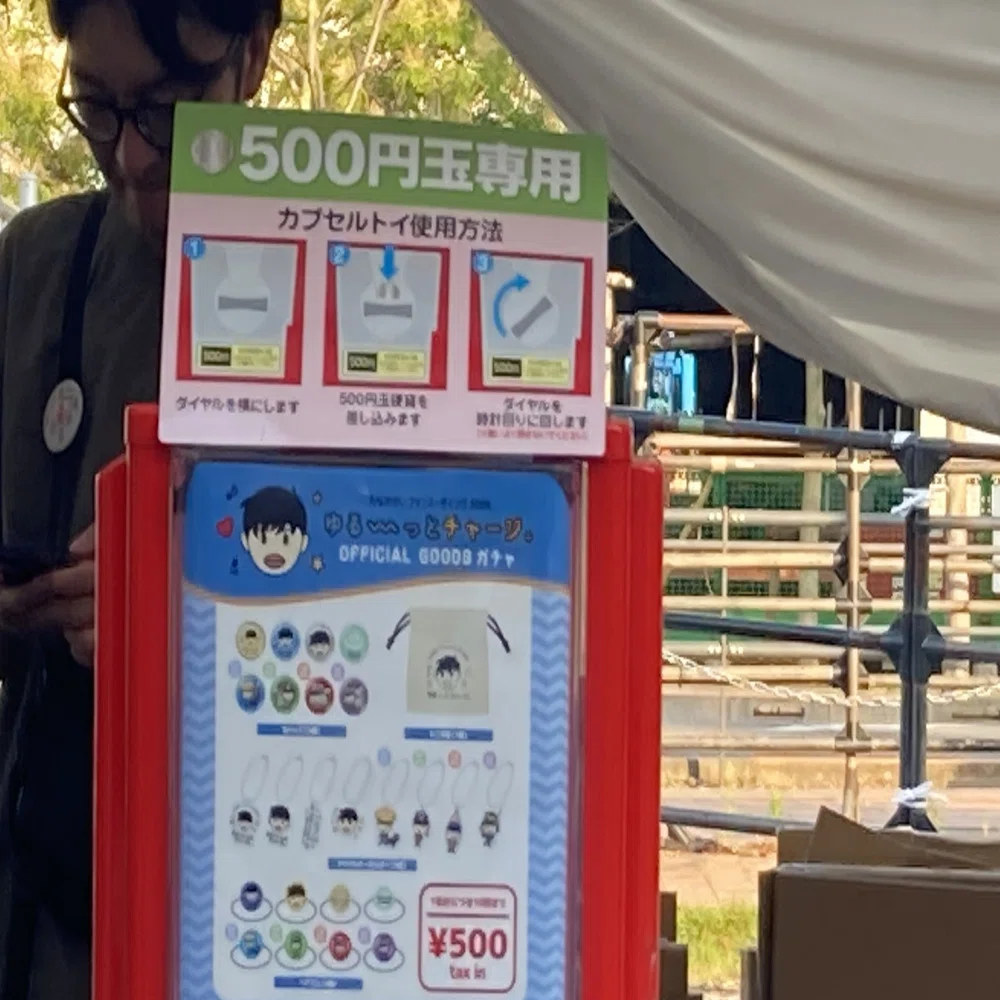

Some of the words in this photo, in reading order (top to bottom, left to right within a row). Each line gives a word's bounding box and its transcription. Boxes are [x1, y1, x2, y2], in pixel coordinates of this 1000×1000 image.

[239, 124, 582, 203] 500円玉専用
[278, 207, 504, 243] カプセルトイ使用方法
[339, 544, 411, 565] OFFICIAL
[428, 926, 508, 960] ¥500
